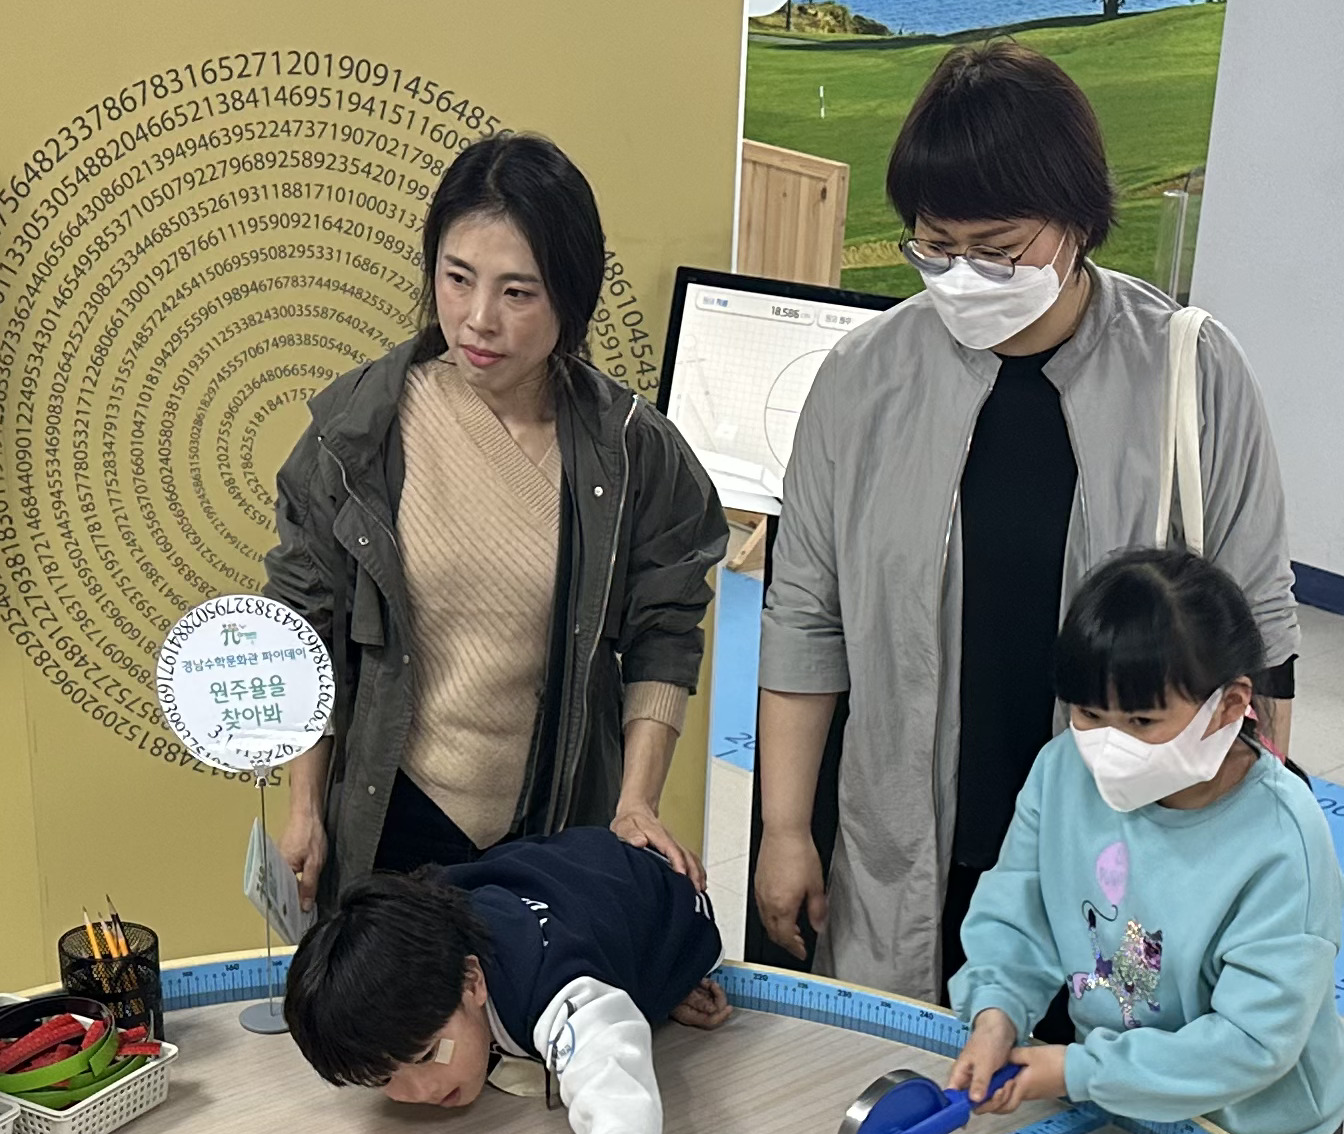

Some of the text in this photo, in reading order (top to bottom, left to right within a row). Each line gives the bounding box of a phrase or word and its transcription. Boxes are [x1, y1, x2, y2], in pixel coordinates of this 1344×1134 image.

[181, 646, 307, 673] 경남수학문화관 파이데이
[209, 674, 286, 704] 원주율을
[221, 702, 284, 731] 찾아봐
